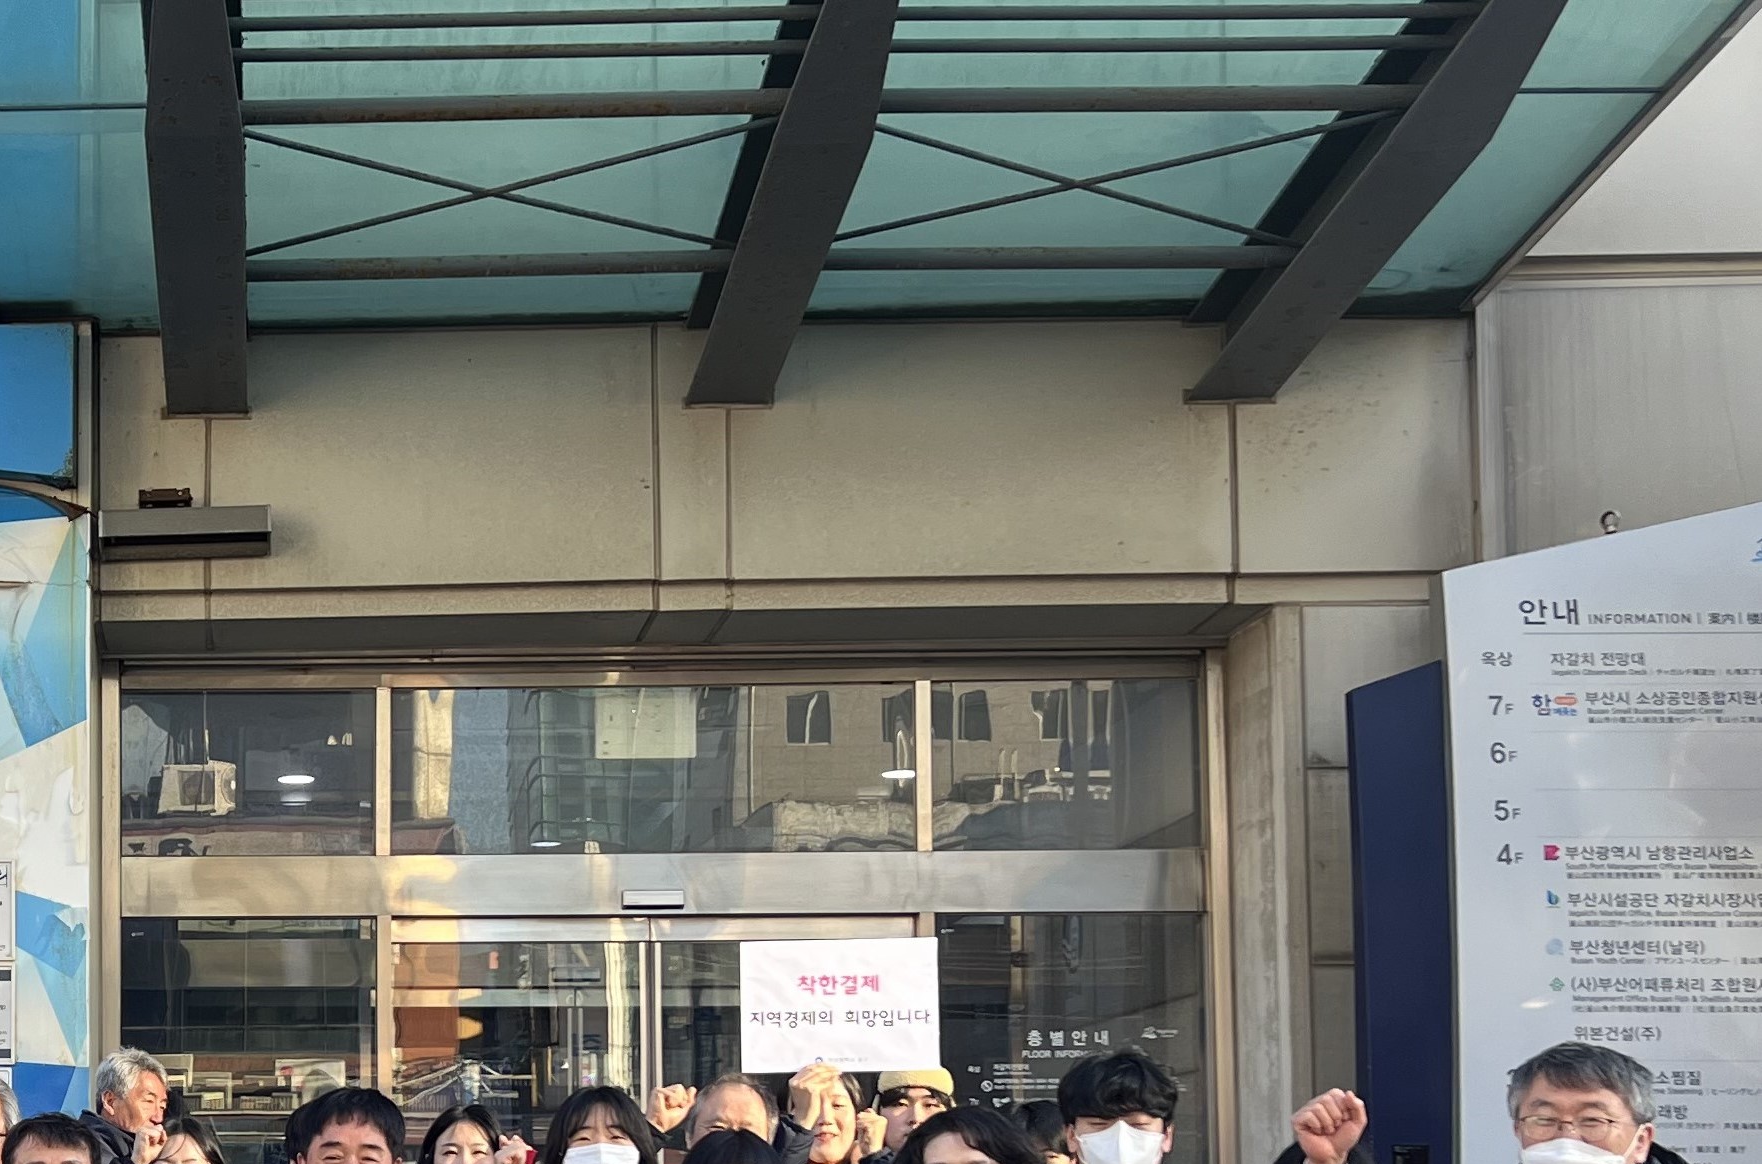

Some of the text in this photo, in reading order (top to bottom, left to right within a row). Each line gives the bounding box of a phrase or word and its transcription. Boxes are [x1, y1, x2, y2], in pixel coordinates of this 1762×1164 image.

[1519, 599, 1579, 625] 안내
[1588, 613, 1691, 625] INFORMATION
[1481, 651, 1513, 667] 옥상
[1551, 652, 1646, 667] 자갈치 전망대
[1565, 845, 1641, 861] 부산광역시
[797, 974, 881, 996] 착한결제
[749, 1009, 930, 1029] 지역경제의 희망입니다
[1653, 1070, 1701, 1086] 소찜질
[1657, 1104, 1688, 1120] 래방
